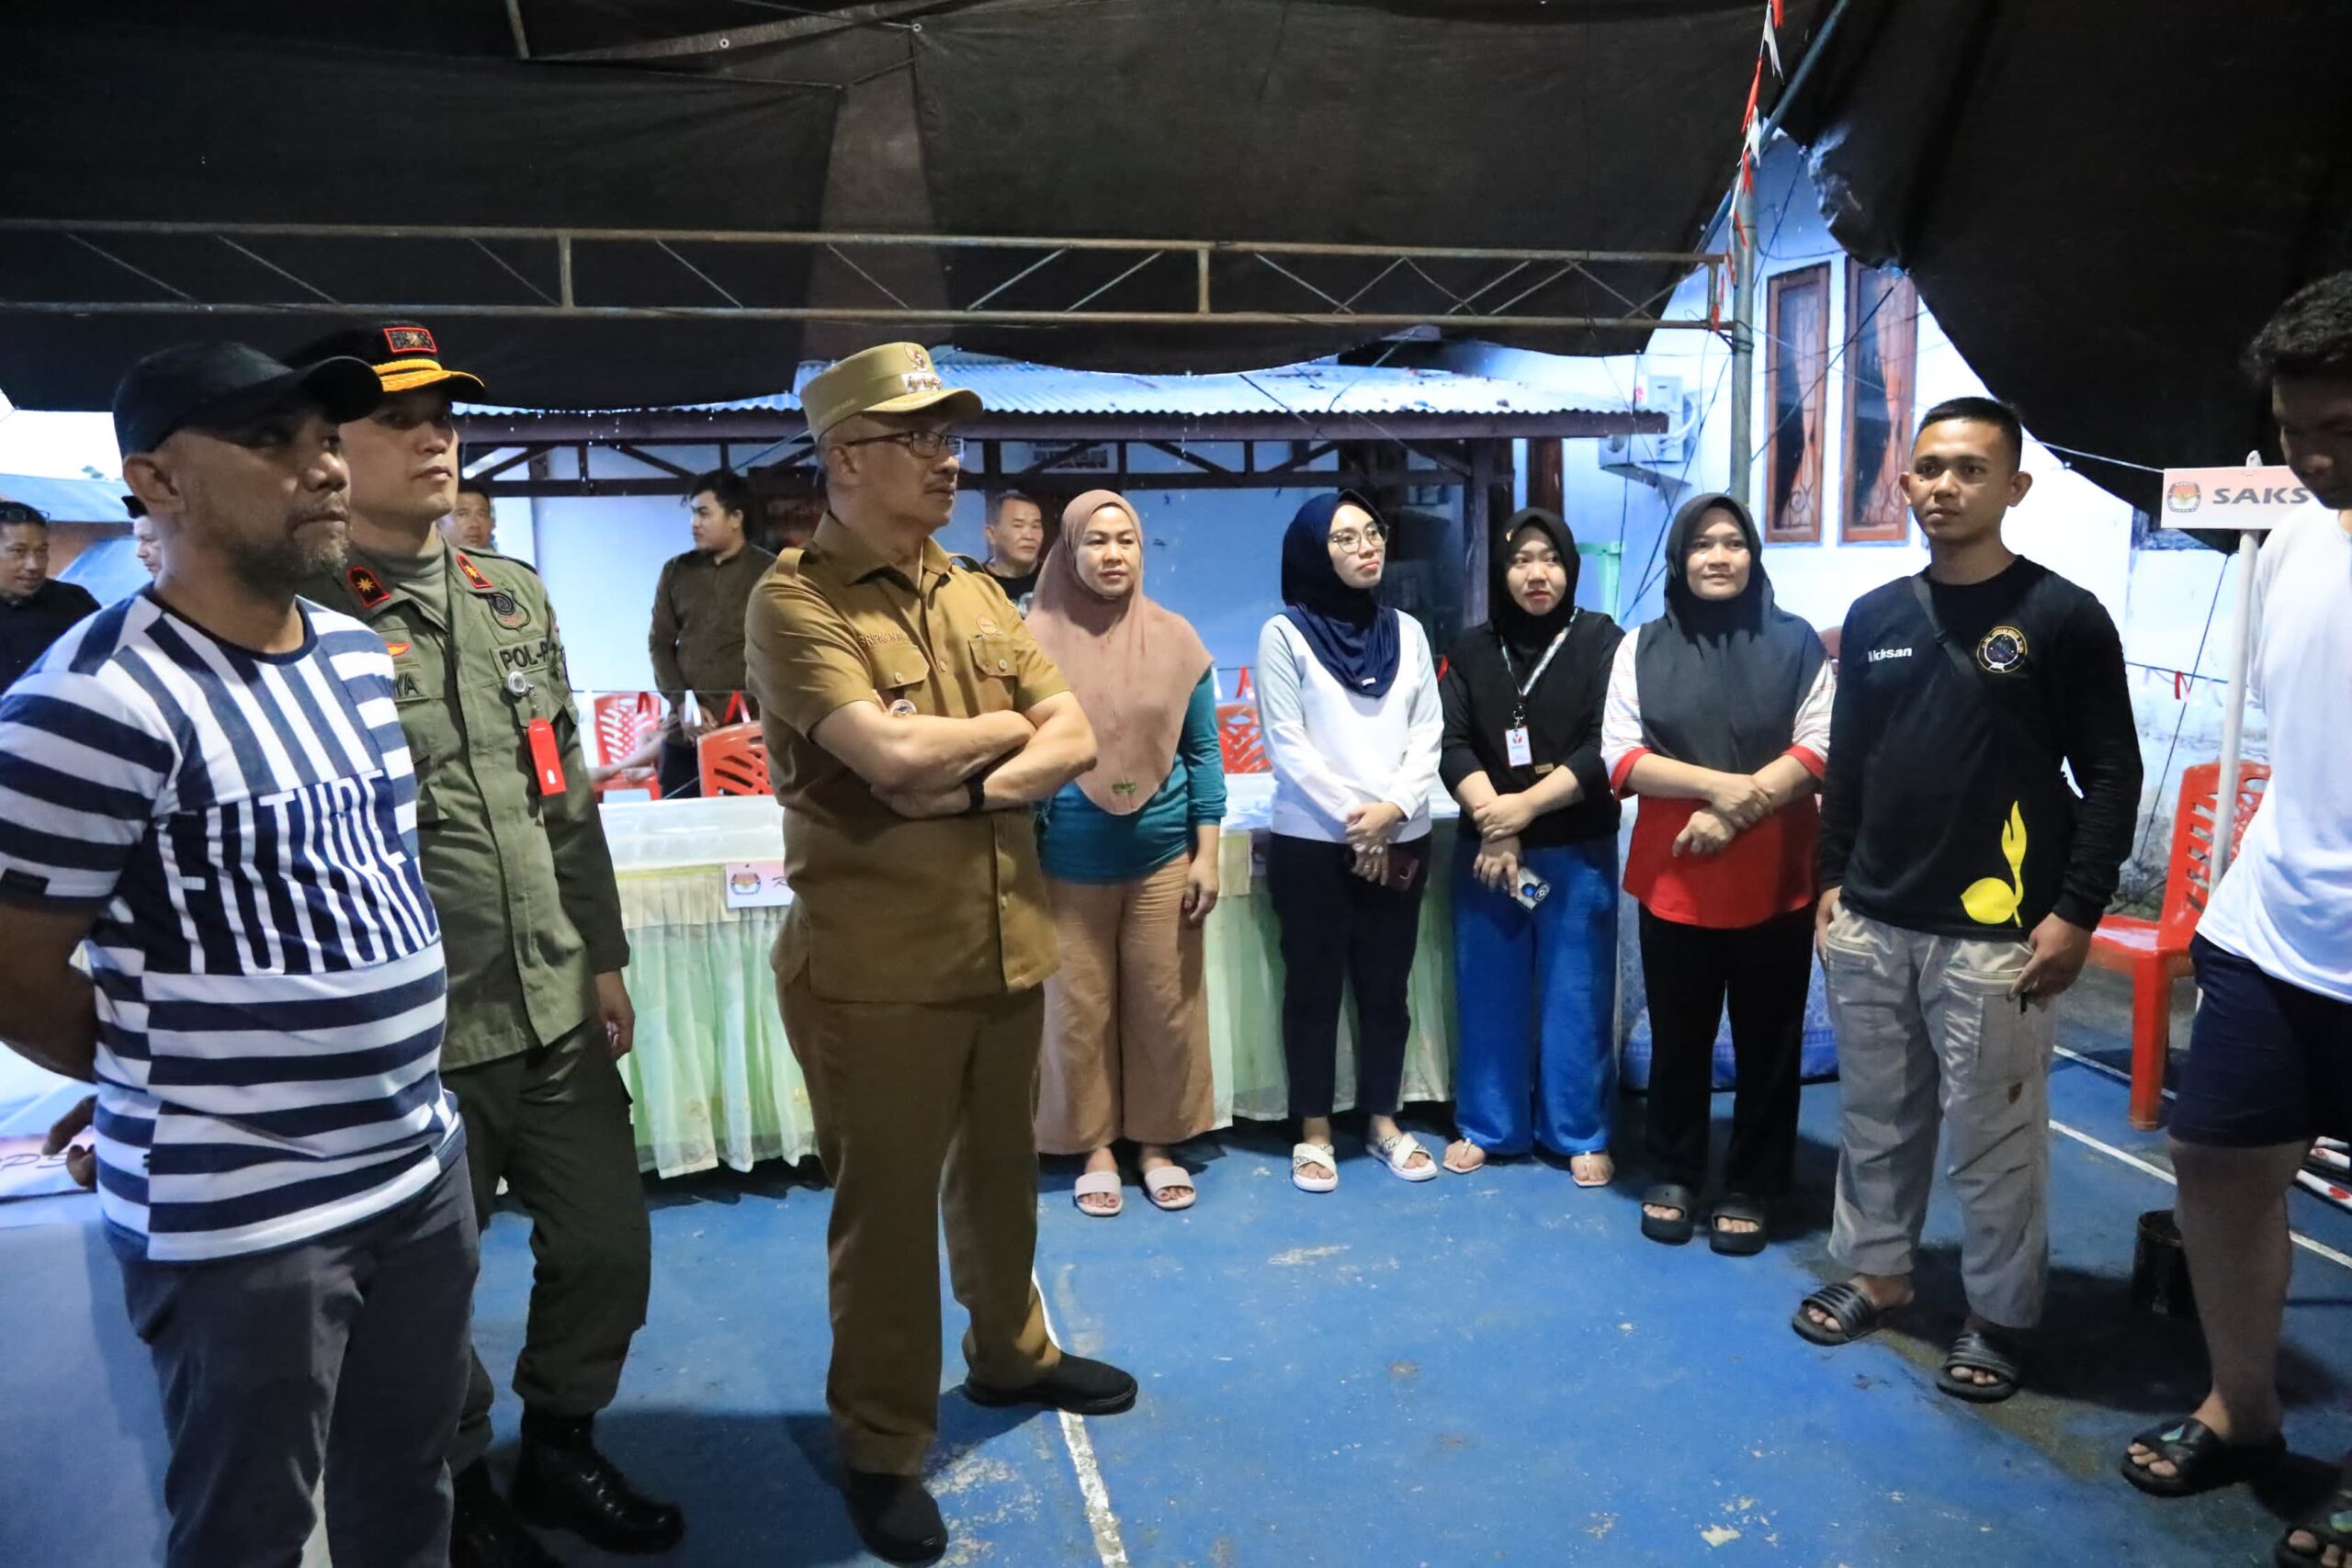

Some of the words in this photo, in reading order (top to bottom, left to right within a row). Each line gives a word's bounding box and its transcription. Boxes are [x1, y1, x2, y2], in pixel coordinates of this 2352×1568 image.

[2212, 487, 2311, 504] SAKS
[500, 640, 549, 671] POL-P
[154, 769, 441, 976] FUTURE
